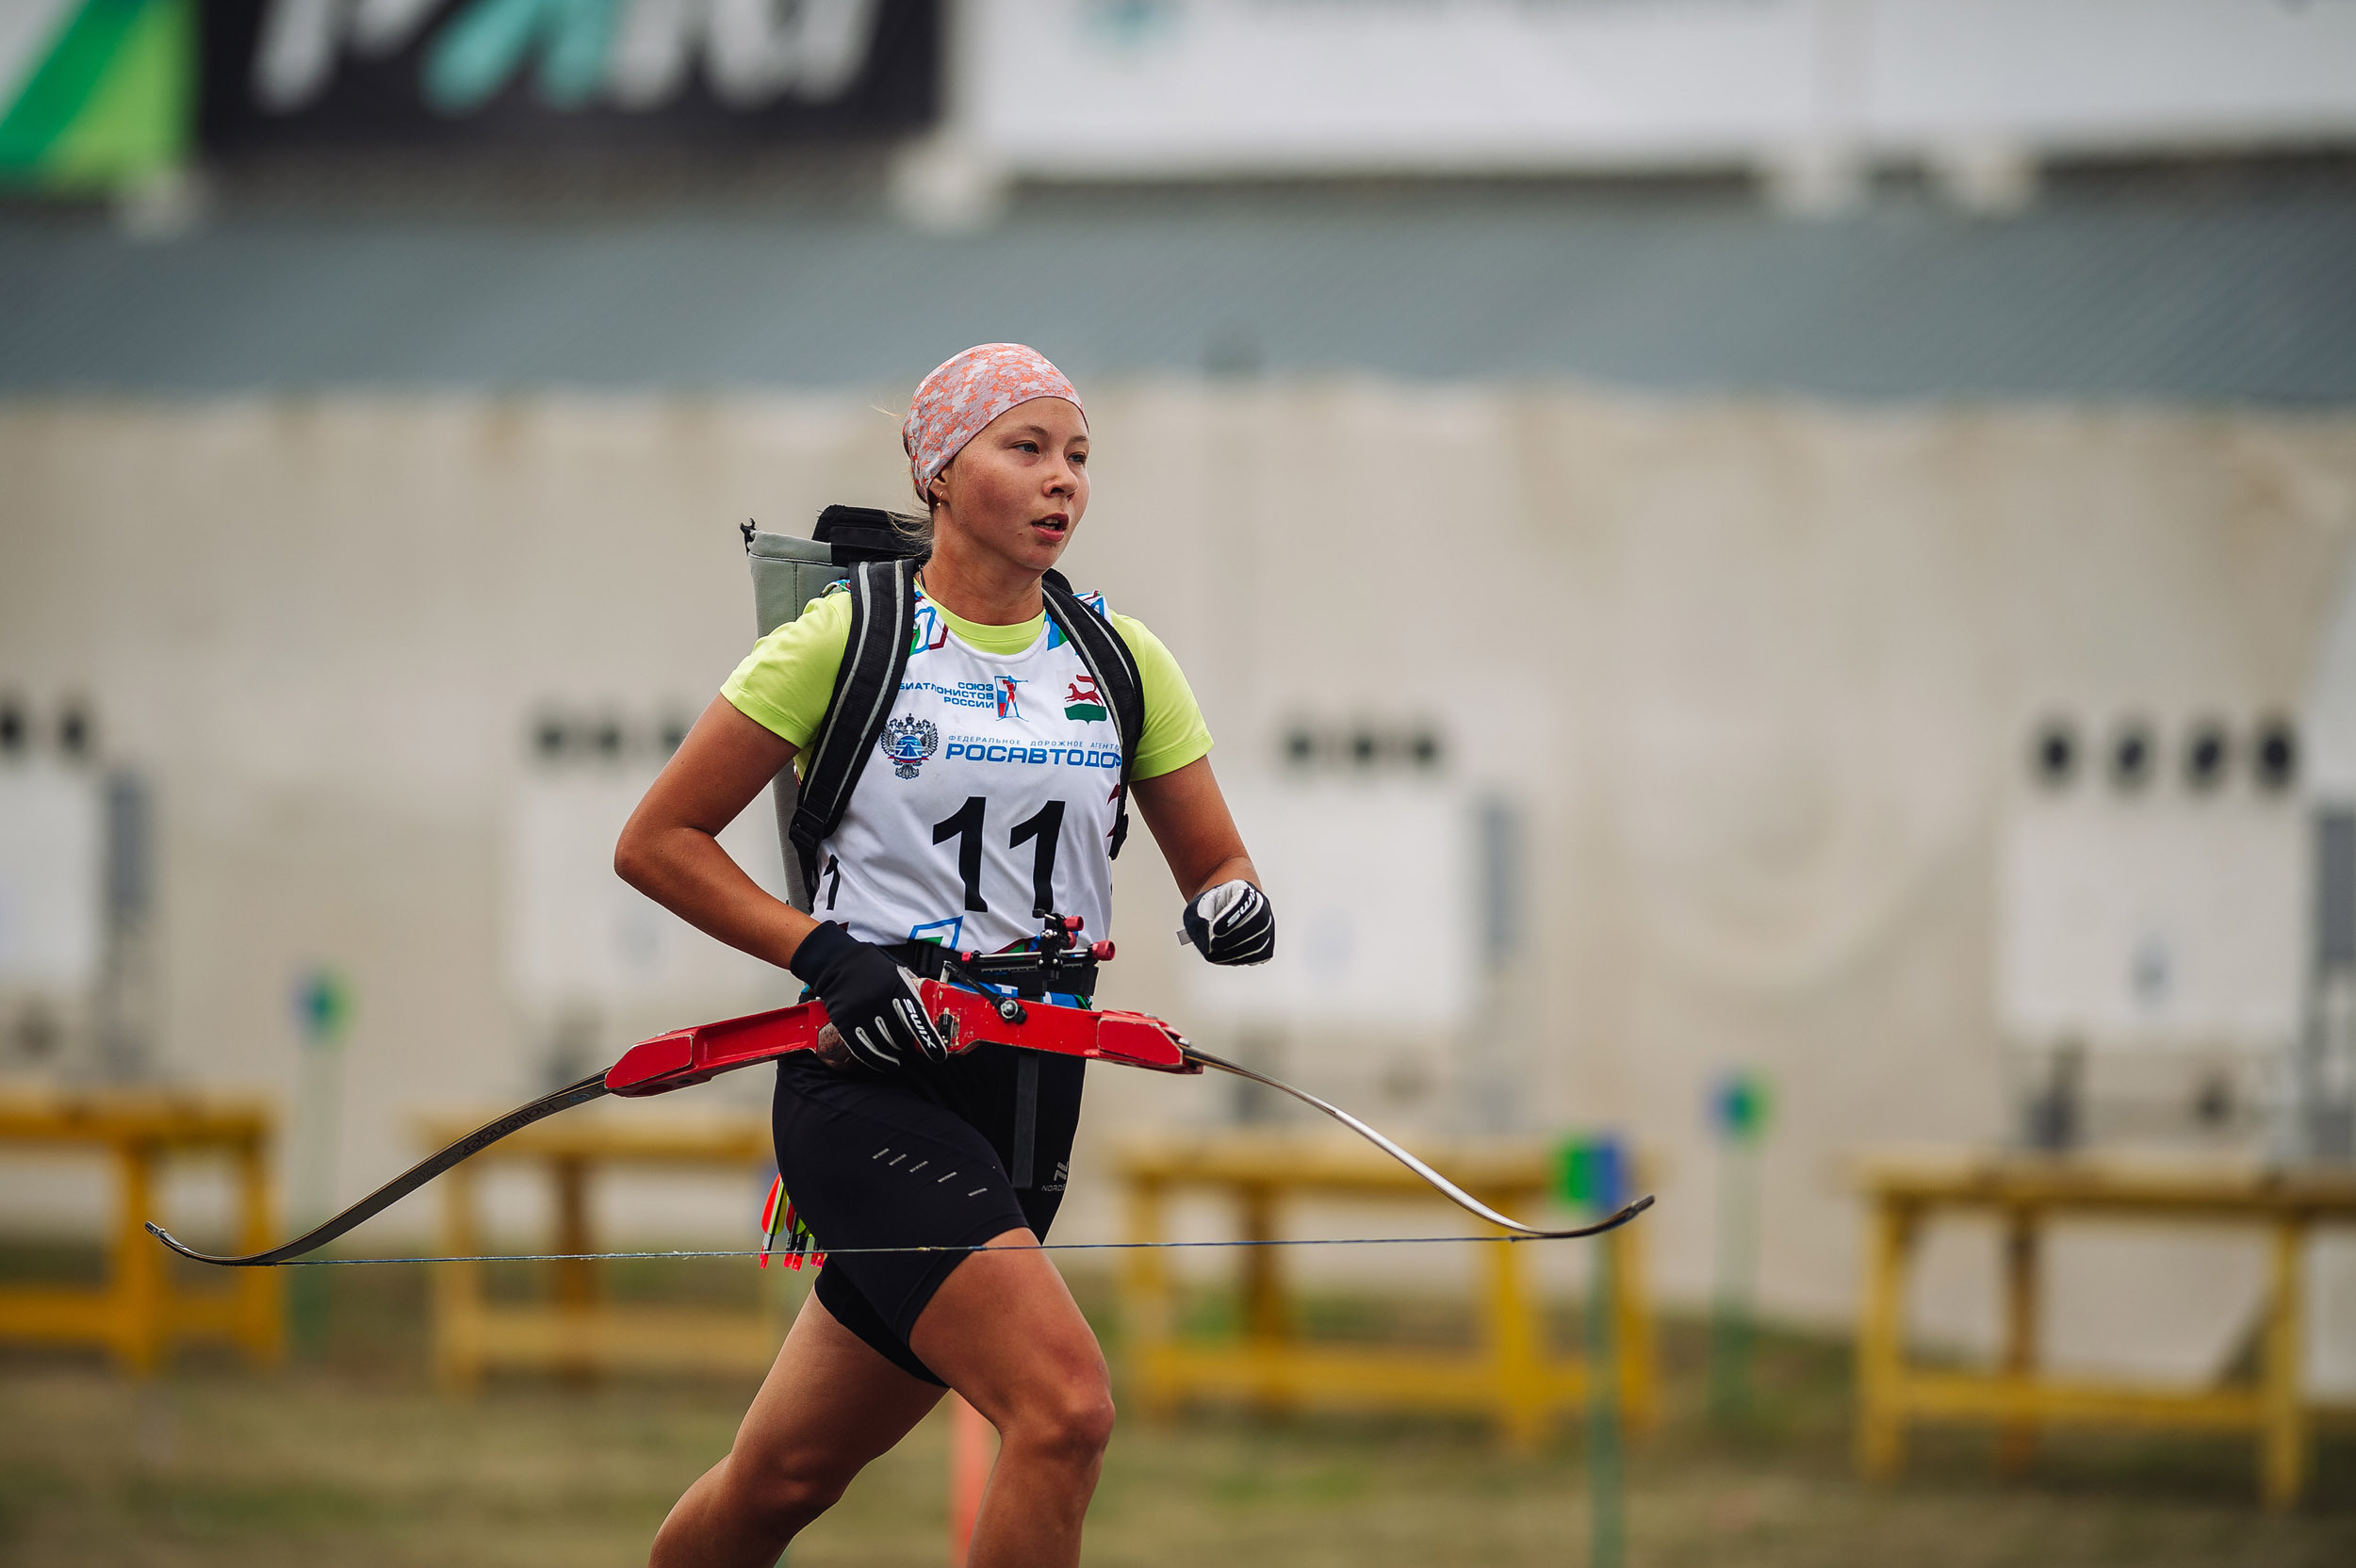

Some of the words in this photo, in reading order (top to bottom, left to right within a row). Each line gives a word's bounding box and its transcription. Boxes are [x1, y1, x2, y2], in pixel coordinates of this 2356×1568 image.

[957, 681, 994, 692] СОЮЗ
[943, 696, 994, 709] РОССИИ
[948, 735, 1022, 745] ФЕДЕРАЛЬНОЕ
[1030, 740, 1084, 748] ДОРОЖНОЕ
[932, 795, 1066, 930] 11
[902, 998, 938, 1049] SWIX
